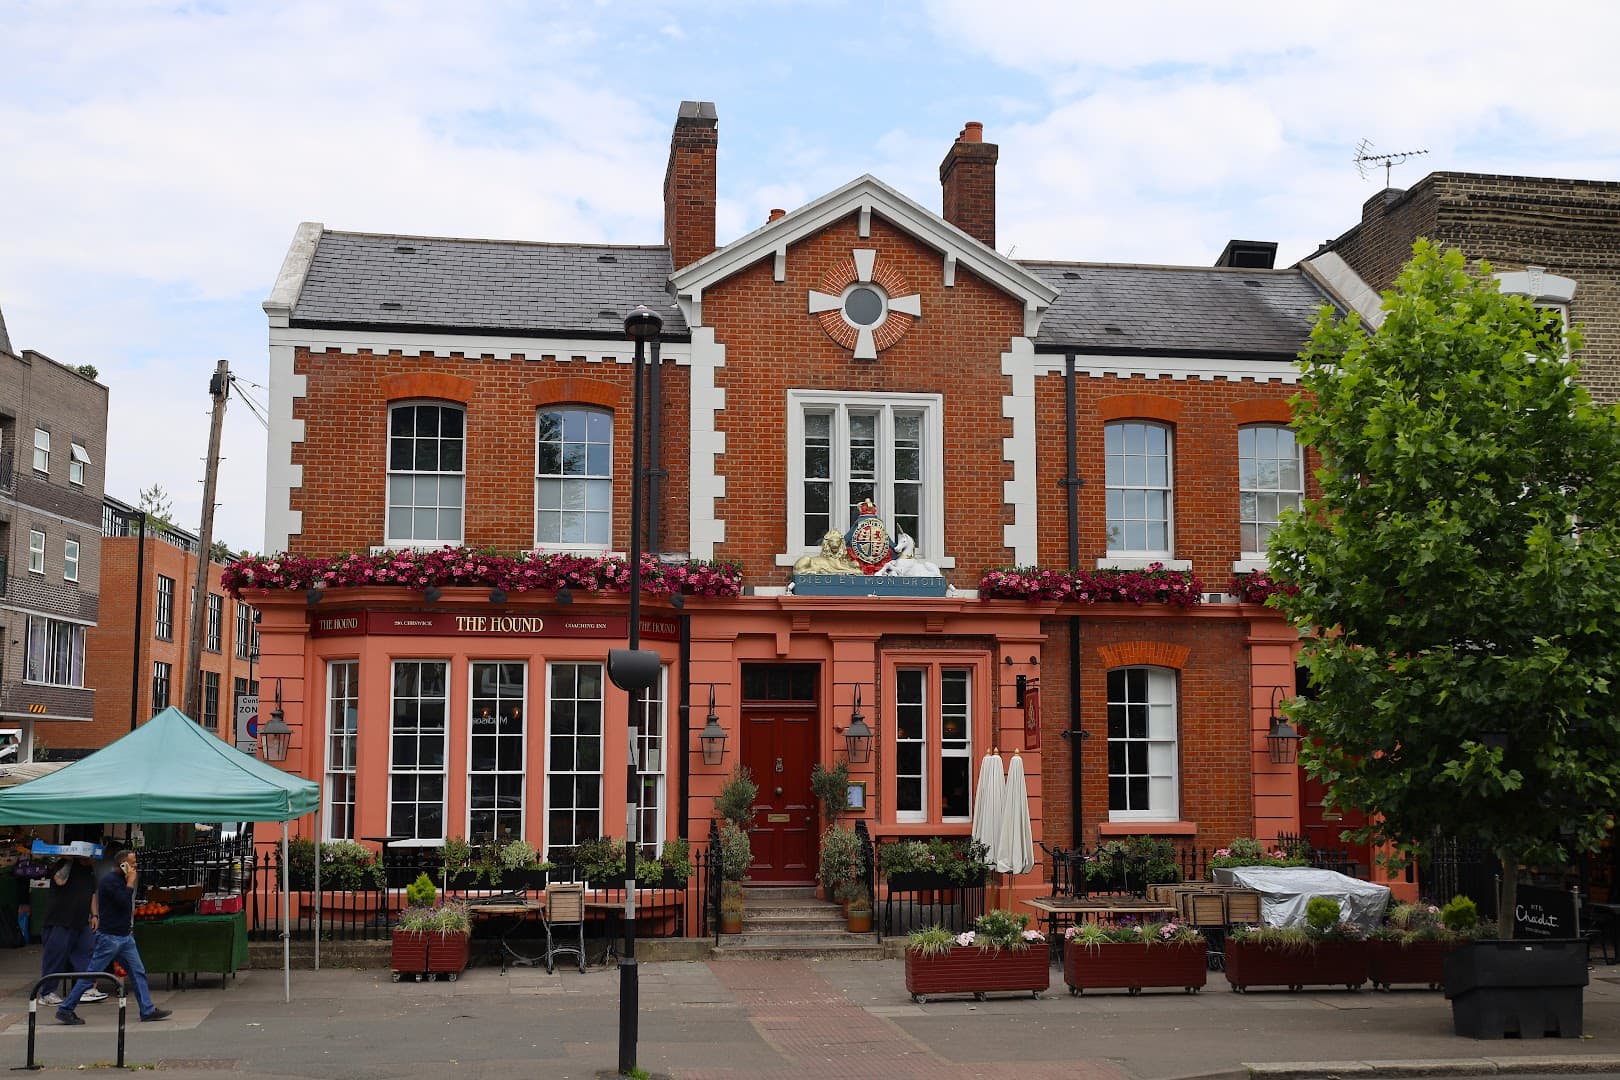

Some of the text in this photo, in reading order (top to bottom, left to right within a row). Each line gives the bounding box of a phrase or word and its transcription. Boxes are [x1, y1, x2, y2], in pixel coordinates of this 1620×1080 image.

[798, 575, 942, 586] DIEU ET MON DROIT
[319, 618, 358, 630] THE HOUND
[456, 616, 544, 632] THE HOUND
[639, 620, 676, 634] THE HOUND
